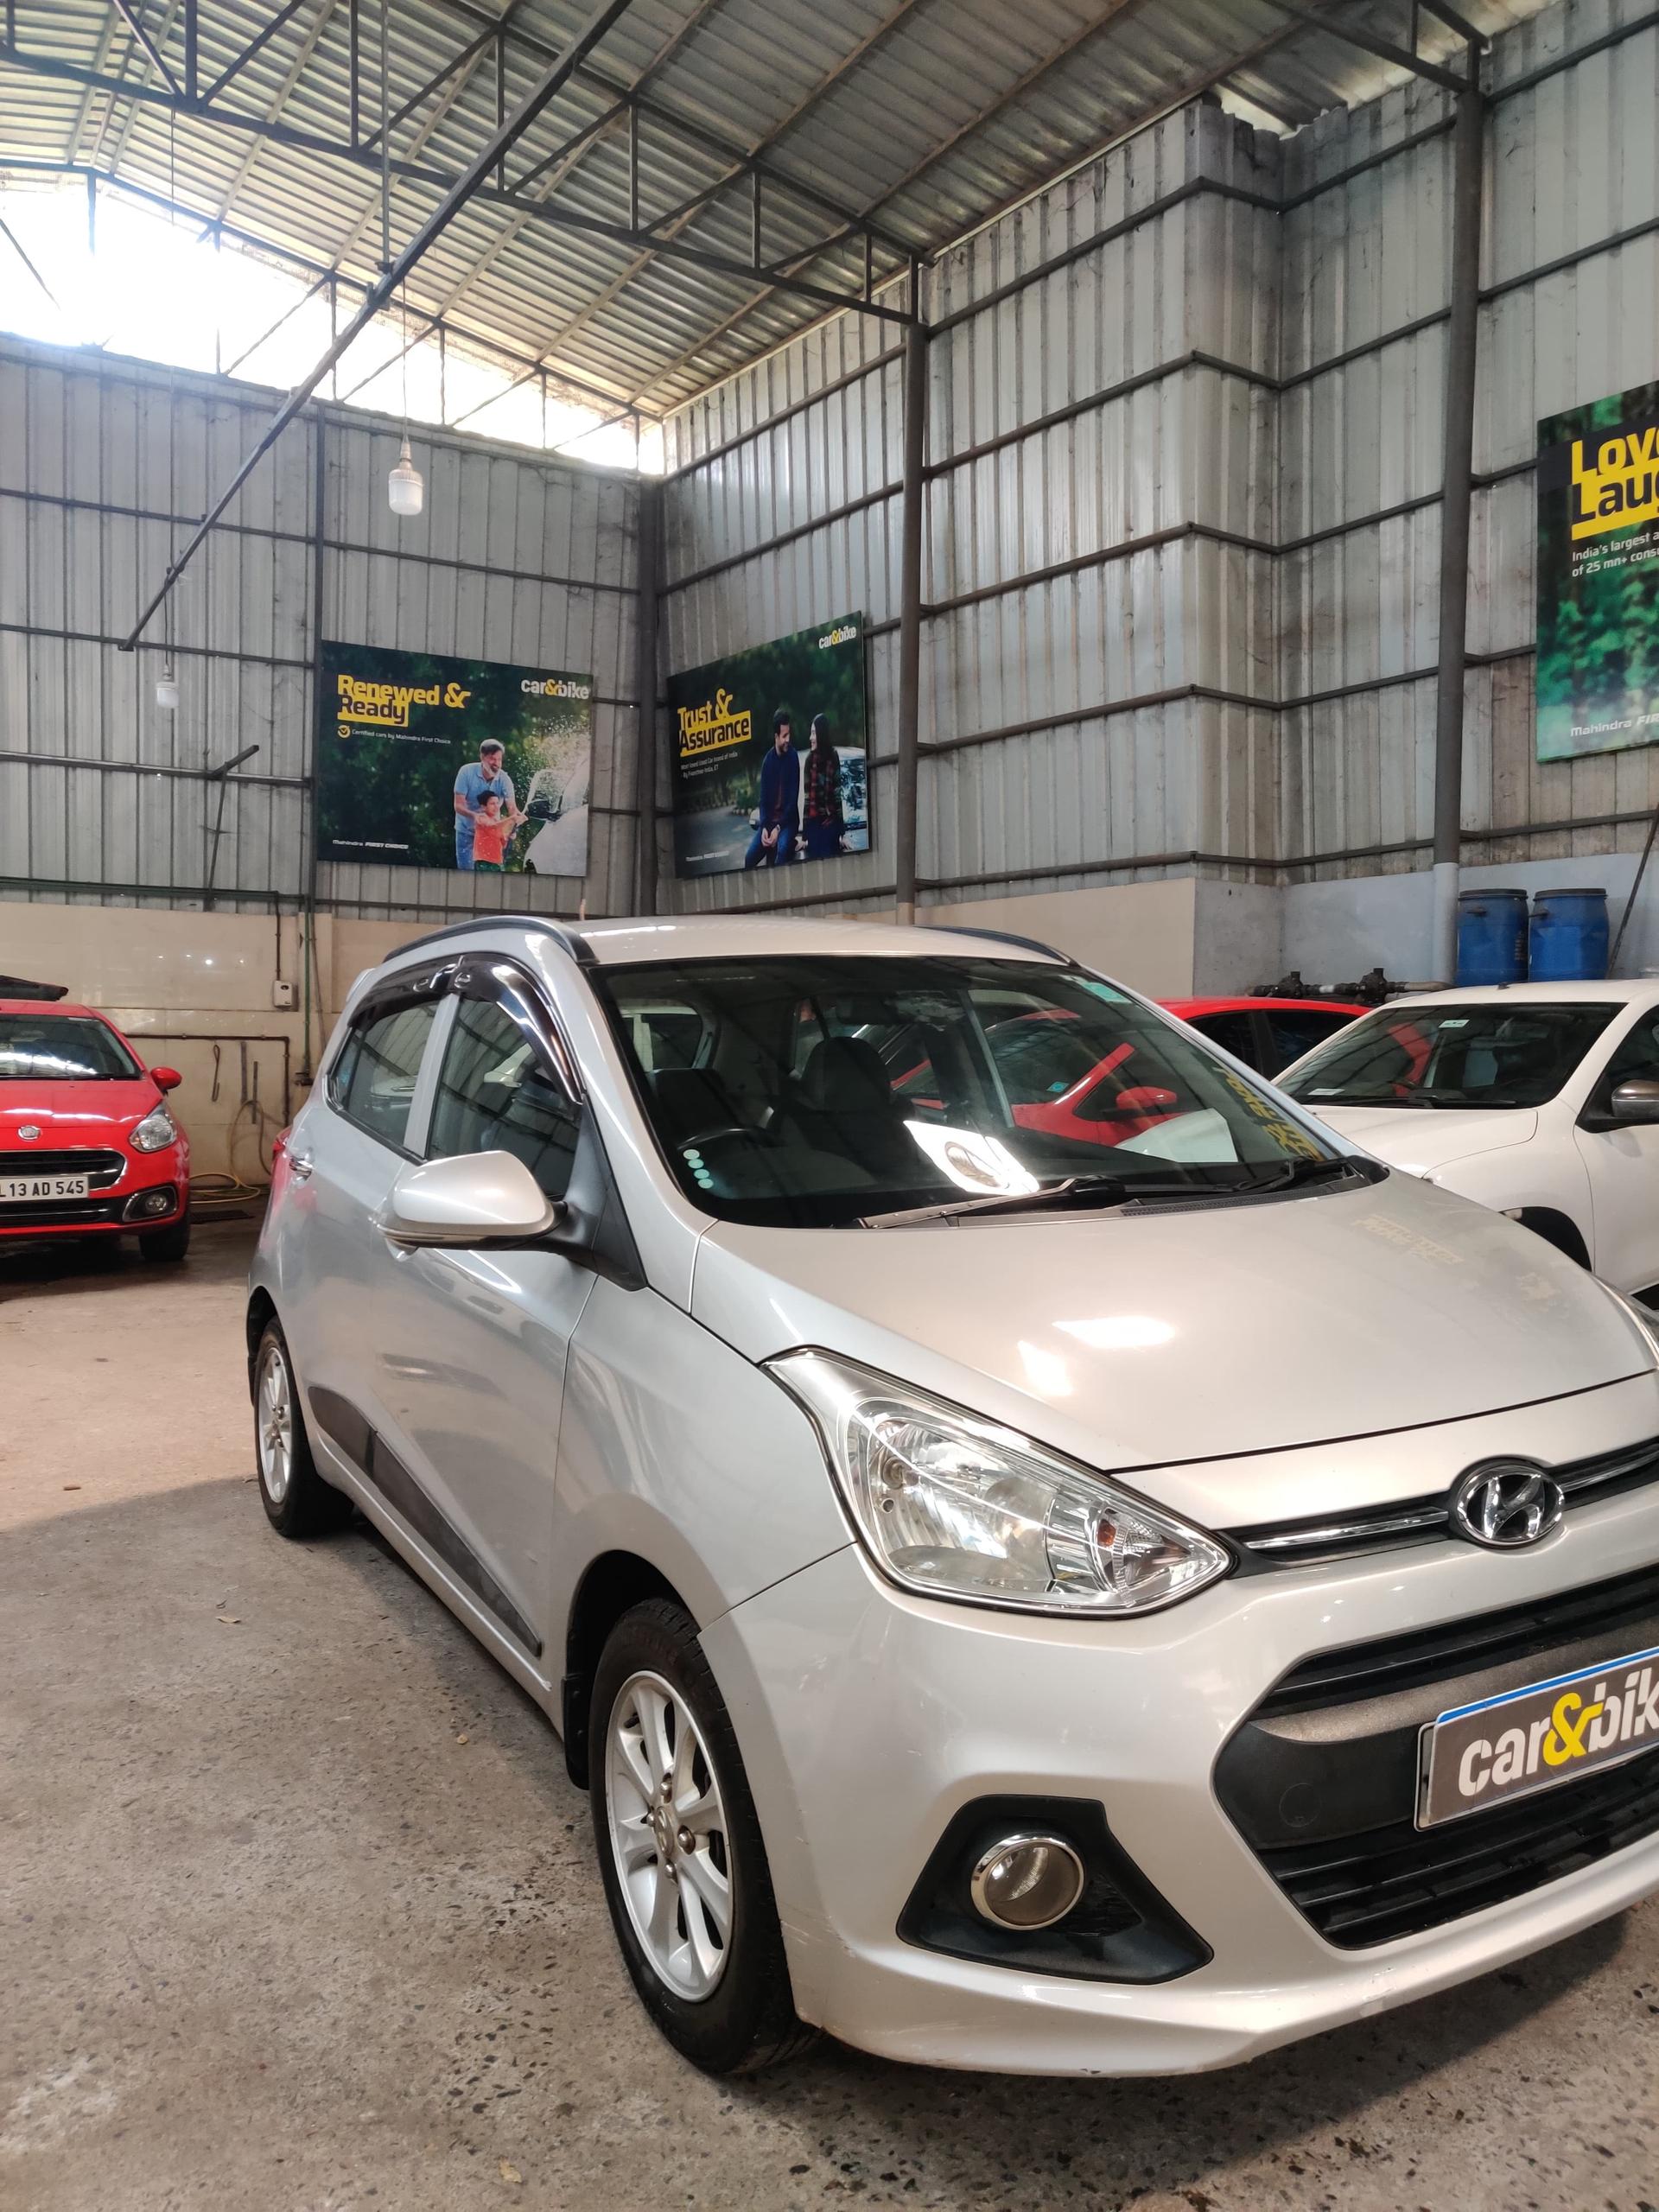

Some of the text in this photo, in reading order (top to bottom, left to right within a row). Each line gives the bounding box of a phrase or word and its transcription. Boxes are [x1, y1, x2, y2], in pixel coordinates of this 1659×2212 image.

[1572, 427, 1659, 485] Lov
[1573, 470, 1659, 524] Lau
[1573, 544, 1609, 562] India's
[1611, 532, 1650, 551] largest
[1573, 564, 1584, 577] of
[1586, 561, 1601, 574] 25
[1604, 557, 1628, 569] mn+
[818, 626, 856, 649] car&bike
[338, 674, 472, 709] Renewed &
[521, 679, 590, 699] car&bike
[340, 695, 405, 725] Ready
[677, 689, 733, 732] Trust &
[679, 717, 750, 752] Assurance
[1571, 720, 1632, 736] Mahindra
[10, 1183, 27, 1197] 13
[32, 1182, 50, 1196] AD
[56, 1180, 84, 1195] 545
